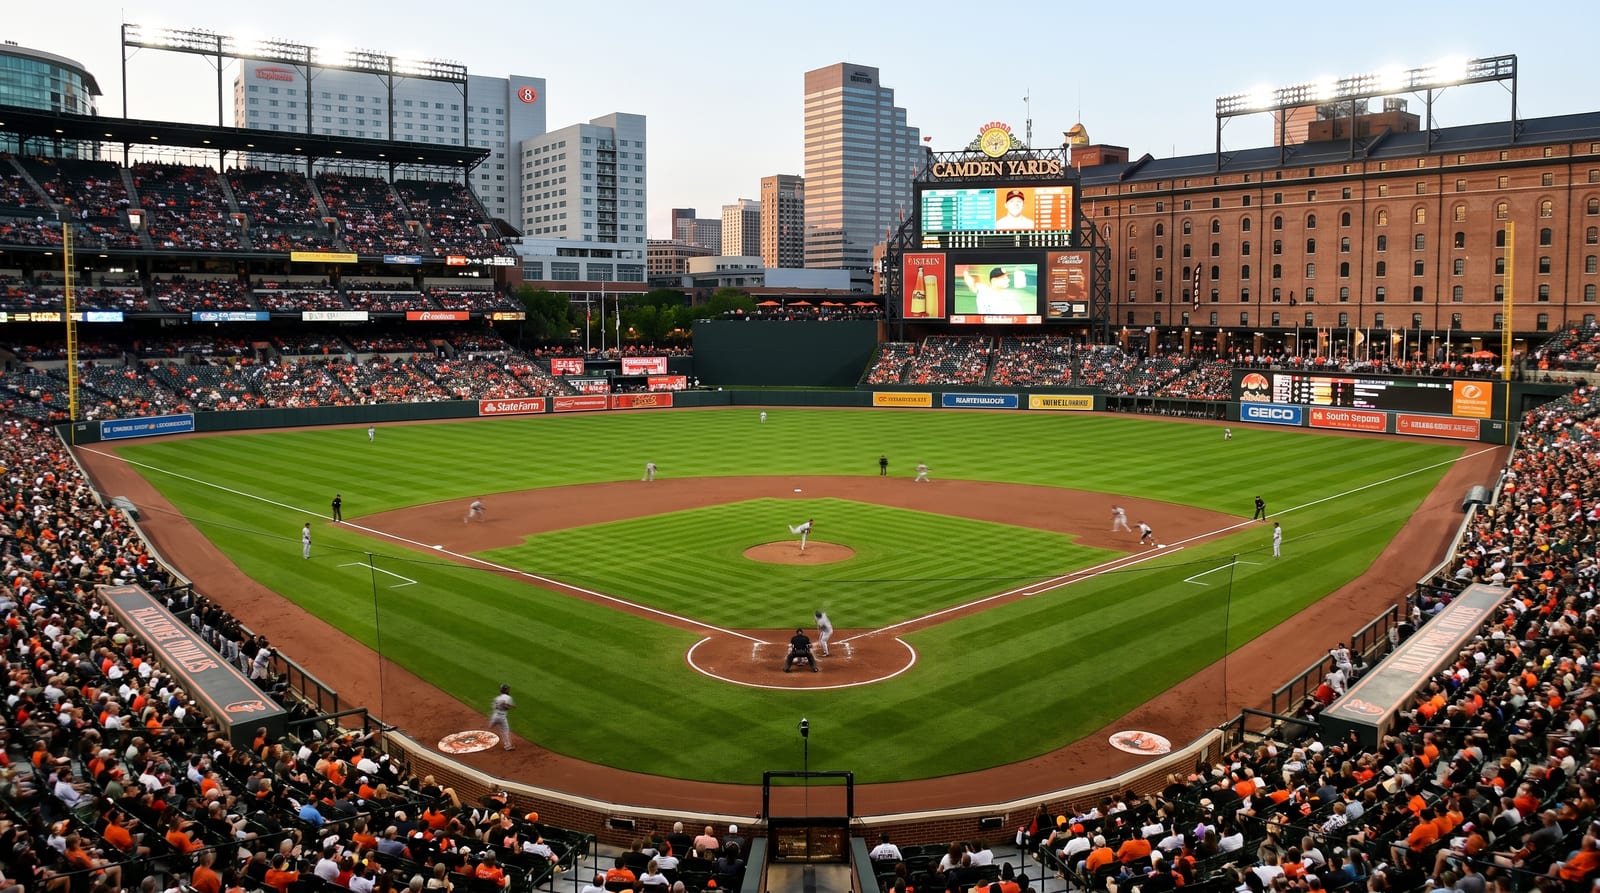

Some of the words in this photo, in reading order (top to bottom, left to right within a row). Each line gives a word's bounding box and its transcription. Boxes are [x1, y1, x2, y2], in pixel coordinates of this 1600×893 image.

[932, 161, 1003, 178] CAMDEN
[1006, 159, 1060, 176] YARDS
[1248, 407, 1294, 420] GEICO
[1326, 412, 1350, 421] South
